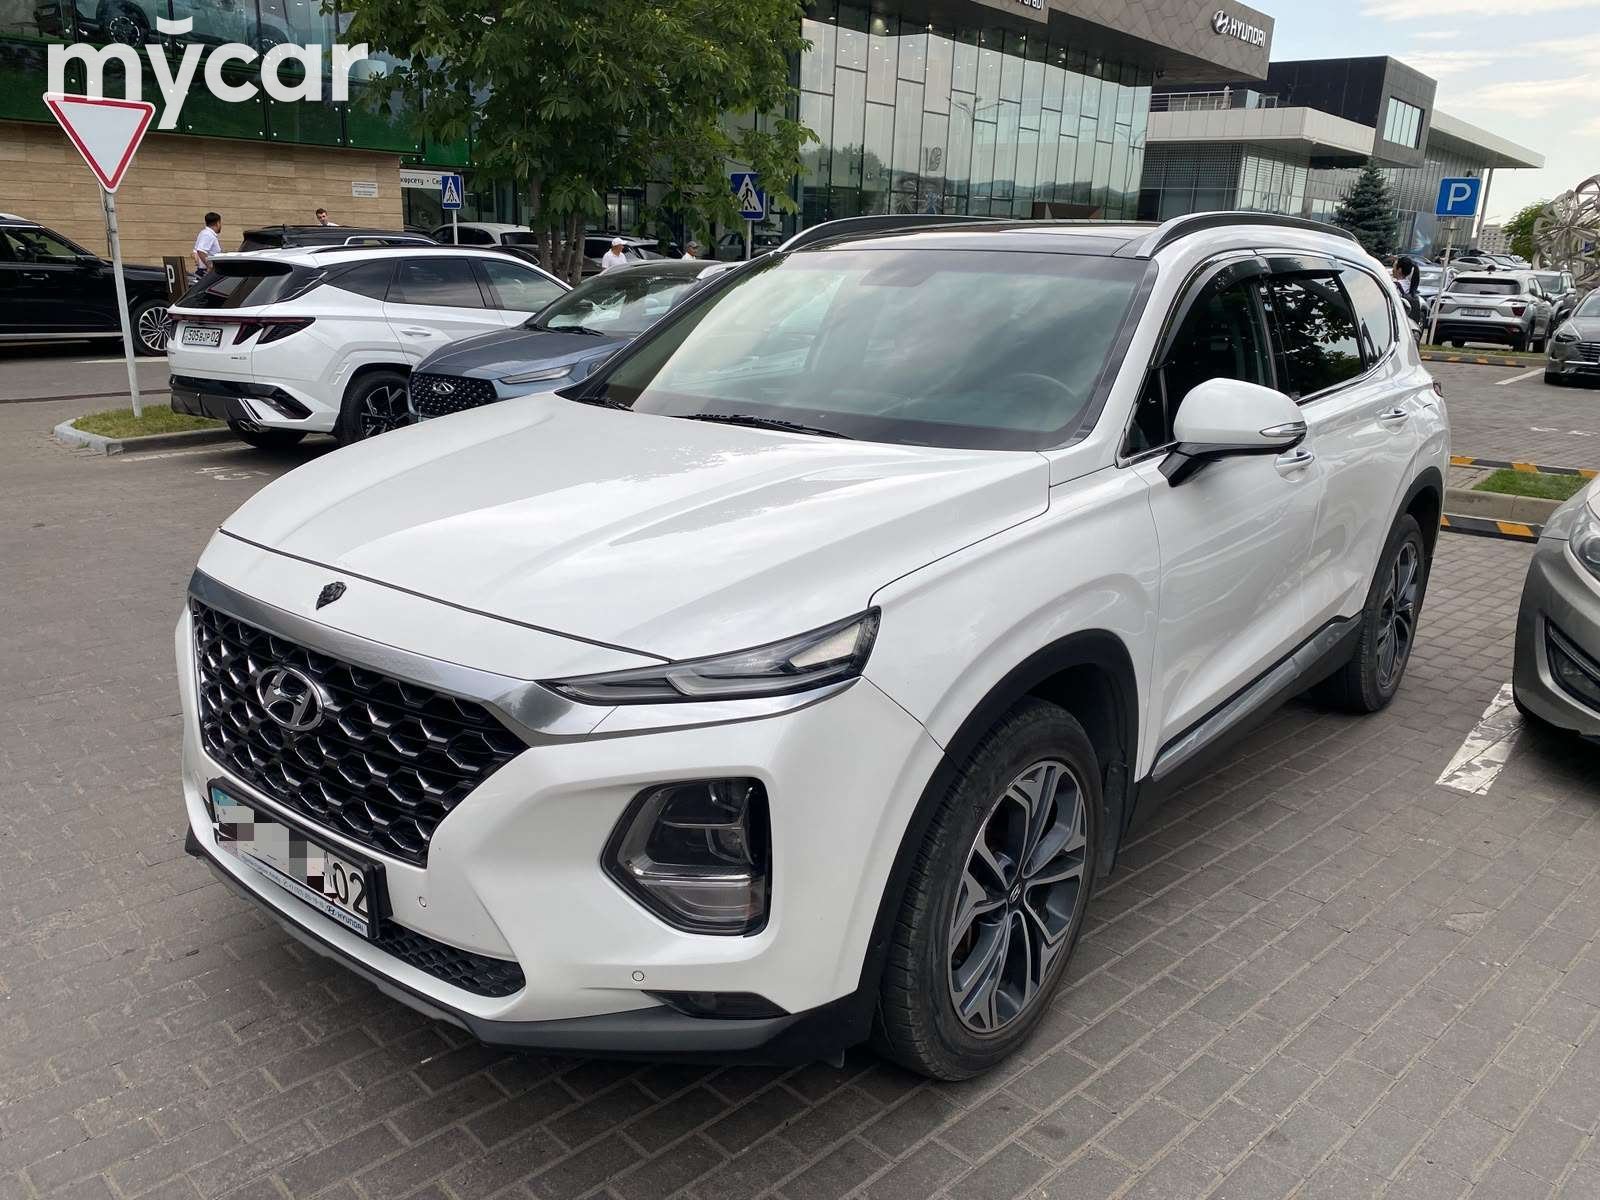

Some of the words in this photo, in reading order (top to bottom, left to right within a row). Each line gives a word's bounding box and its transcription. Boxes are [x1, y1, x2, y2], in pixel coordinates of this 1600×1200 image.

[1230, 17, 1267, 48] HYUNDAI
[1447, 182, 1472, 211] P
[166, 264, 175, 294] P
[332, 861, 368, 919] 02
[336, 911, 365, 933] HYUNDAI
